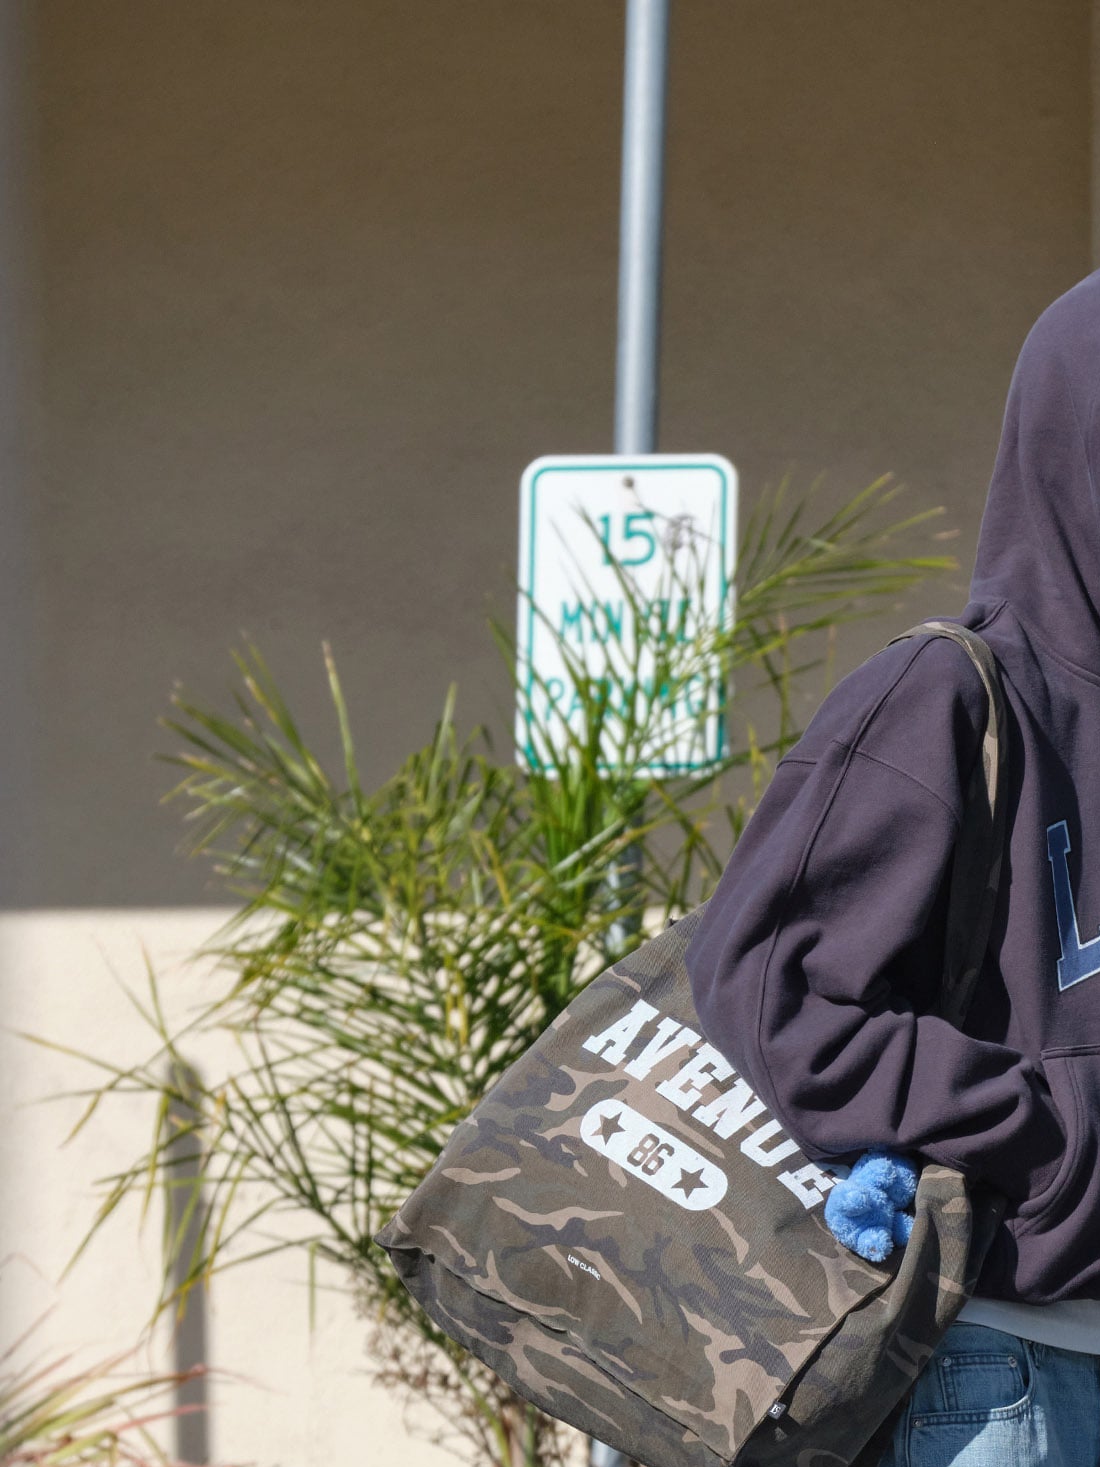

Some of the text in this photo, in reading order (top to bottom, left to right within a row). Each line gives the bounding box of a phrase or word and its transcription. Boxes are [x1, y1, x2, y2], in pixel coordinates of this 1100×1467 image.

[599, 511, 656, 566] 15
[581, 998, 851, 1211] AVENUE
[626, 1133, 675, 1177] 86
[567, 1254, 580, 1267] LOW
